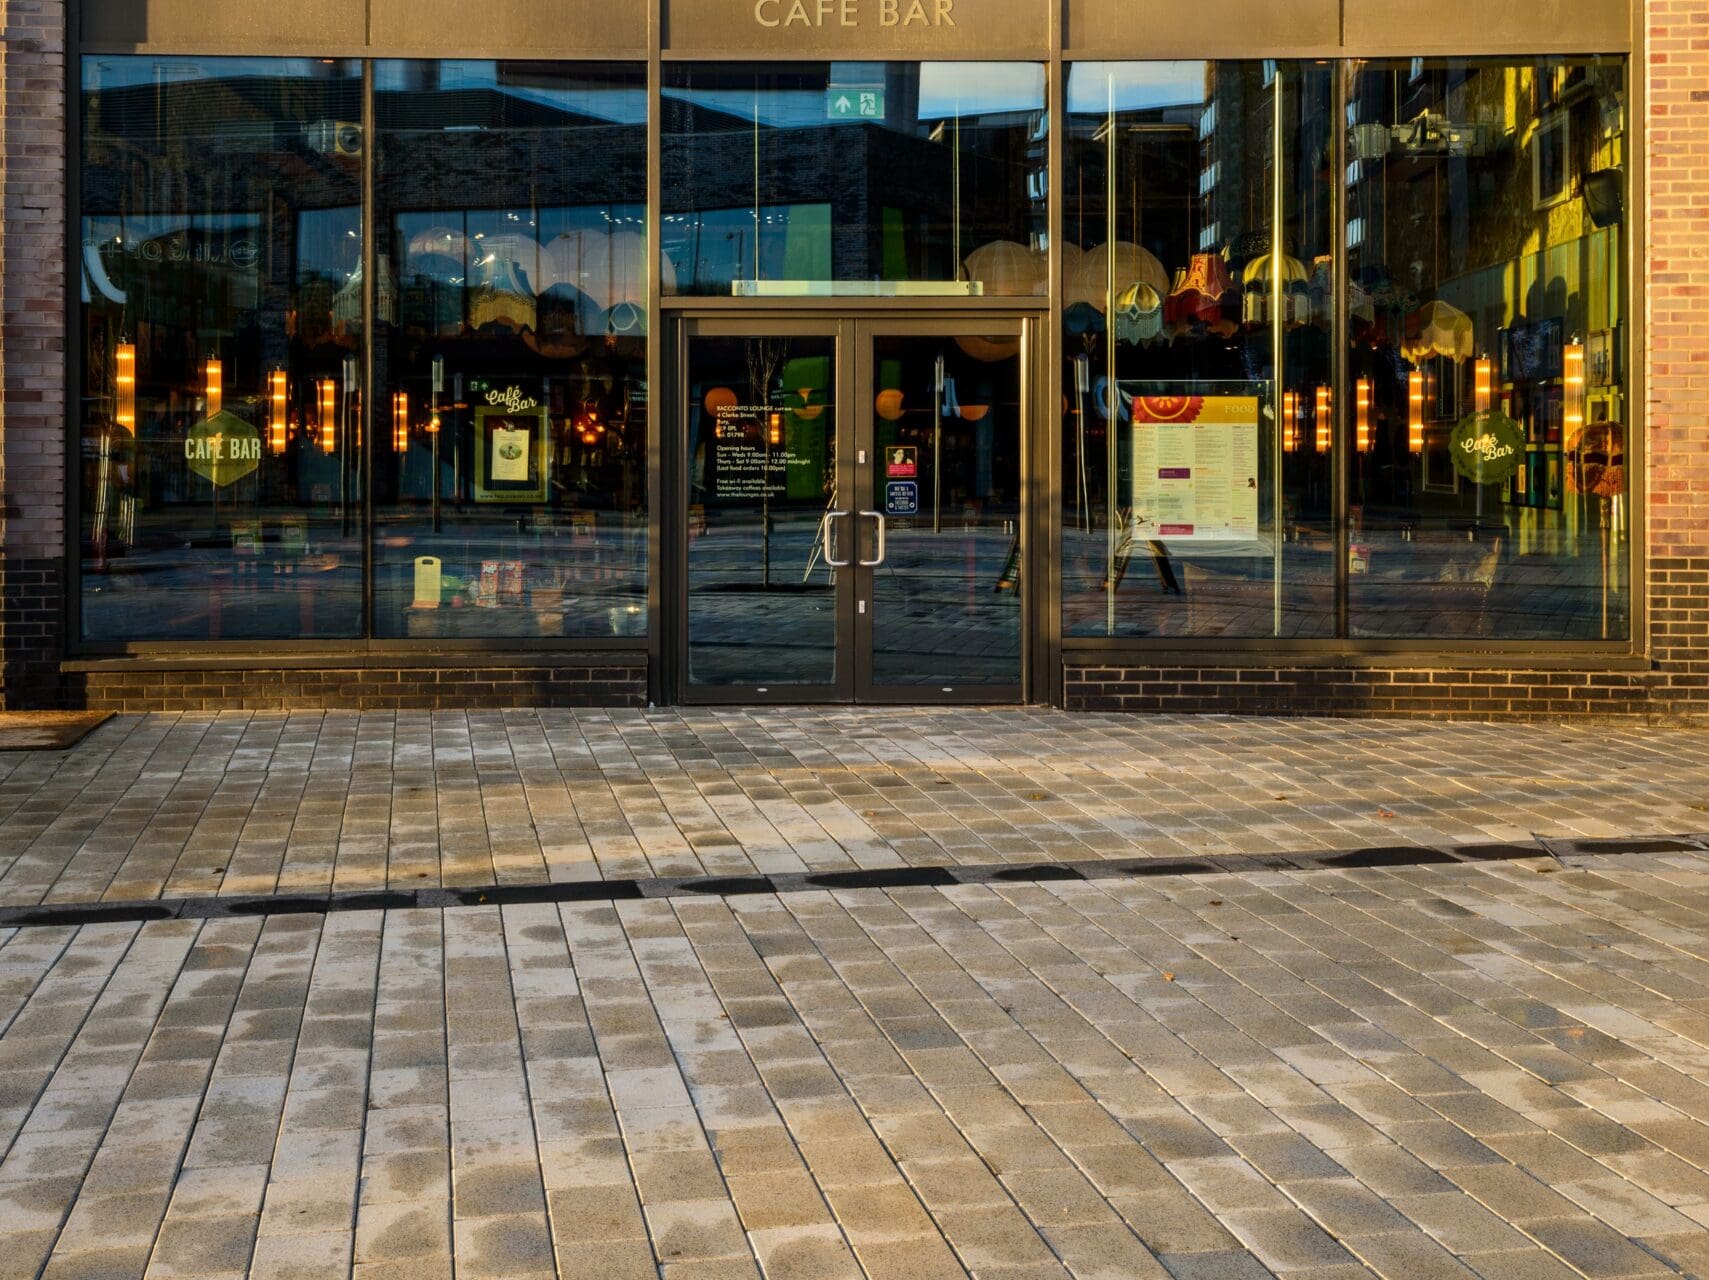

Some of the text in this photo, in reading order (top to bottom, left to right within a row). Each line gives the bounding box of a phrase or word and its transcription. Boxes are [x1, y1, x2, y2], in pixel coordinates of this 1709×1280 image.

[485, 385, 537, 413] Café Bar
[1224, 403, 1256, 414] FOOD
[230, 438, 262, 460] BAR
[1460, 433, 1514, 461] Café Bar
[787, 458, 811, 466] midnight
